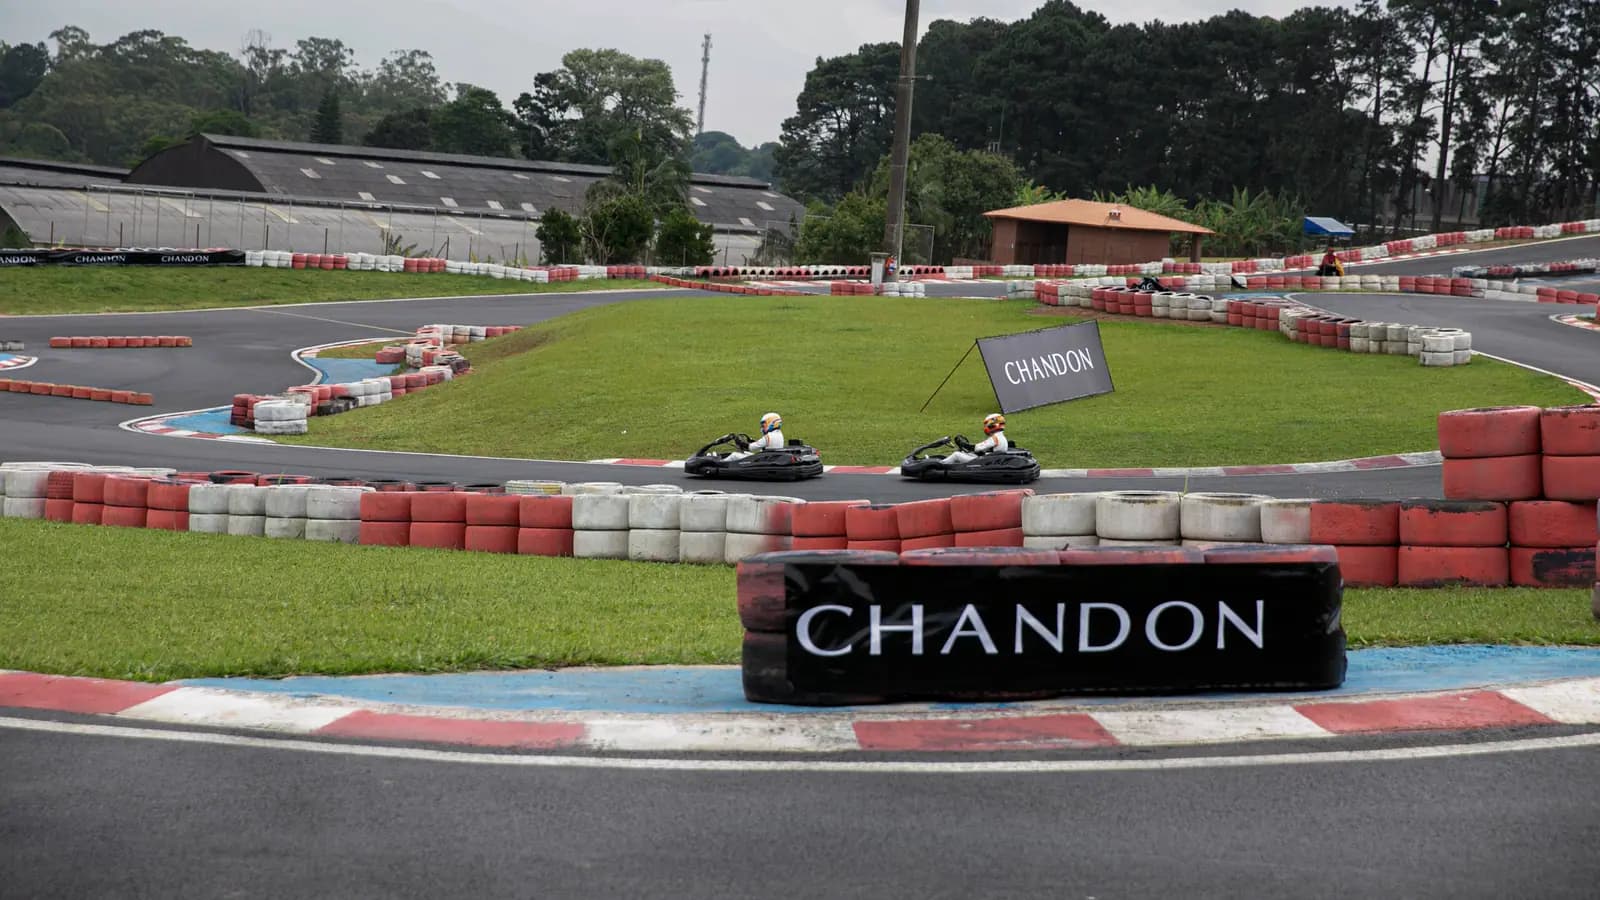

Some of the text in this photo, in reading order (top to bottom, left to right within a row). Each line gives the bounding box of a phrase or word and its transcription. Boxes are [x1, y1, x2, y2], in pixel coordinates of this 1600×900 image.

[161, 255, 209, 263] CHANDON
[1004, 347, 1095, 386] CHANDON
[796, 600, 1265, 656] CHANDON
